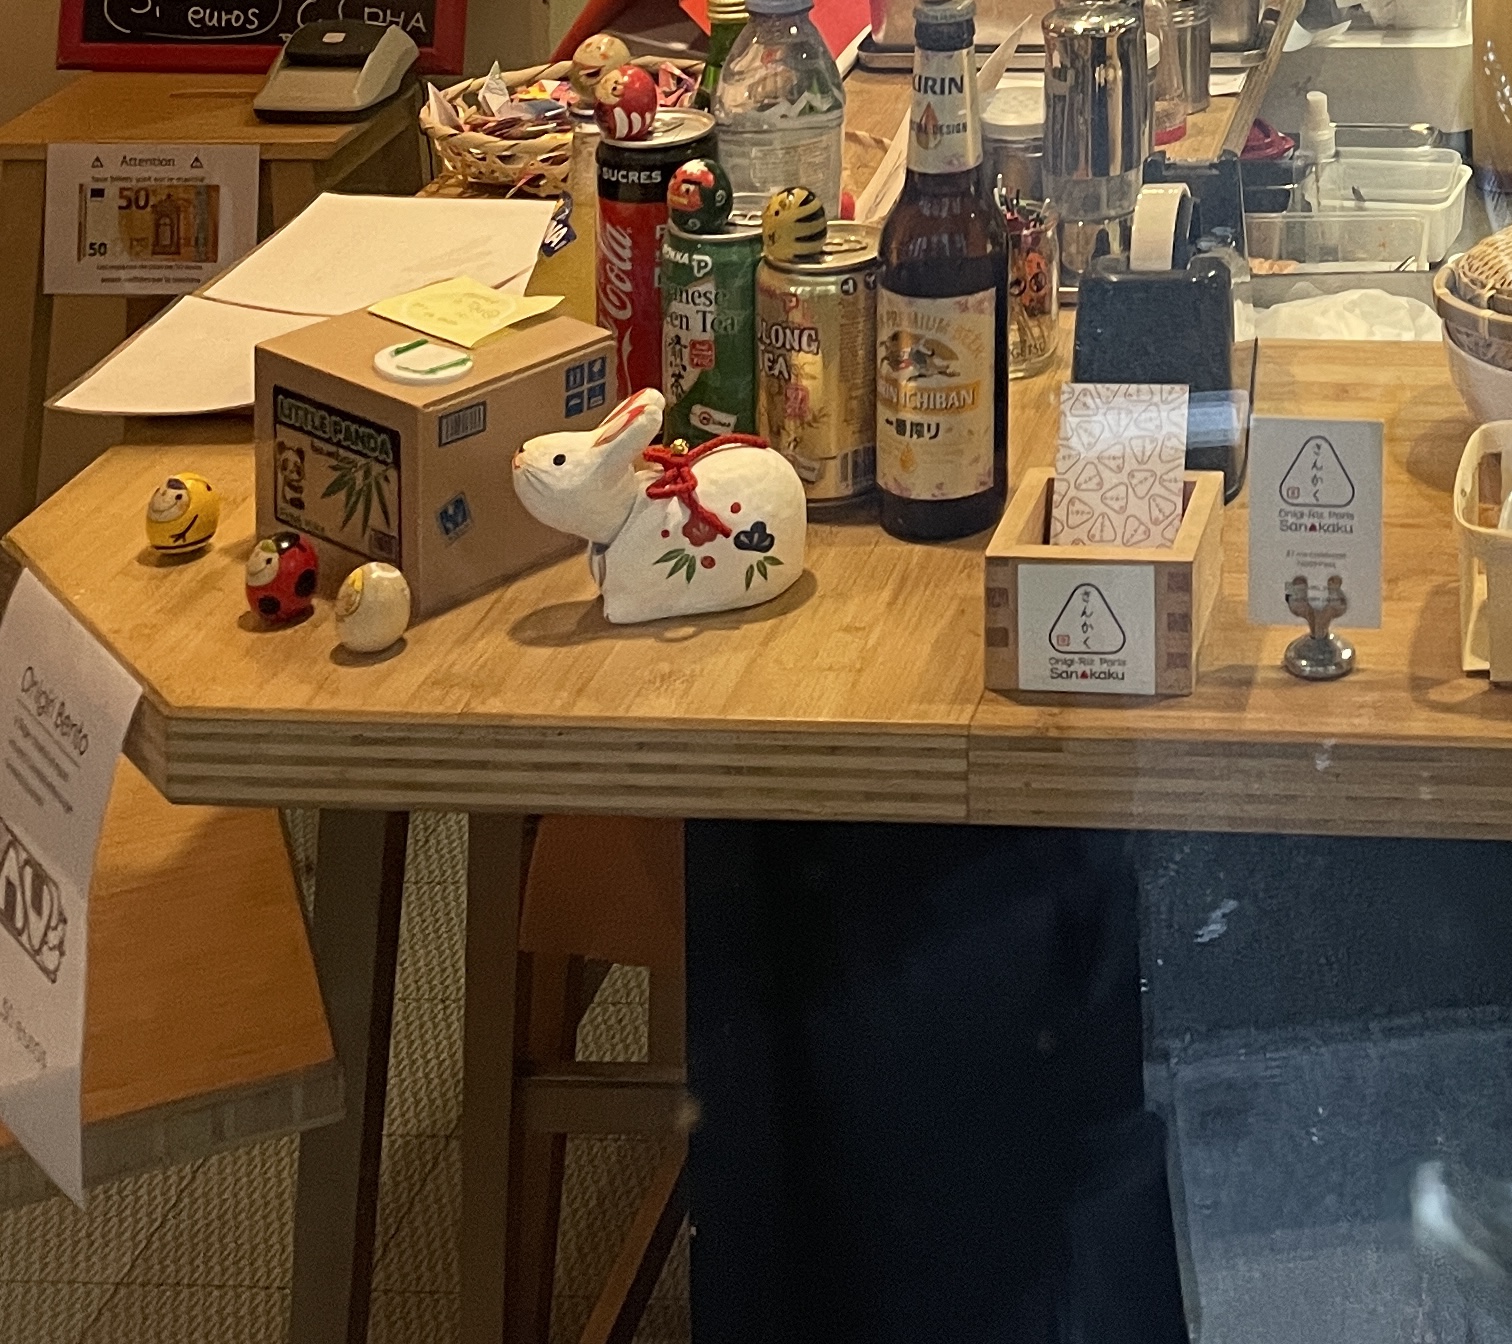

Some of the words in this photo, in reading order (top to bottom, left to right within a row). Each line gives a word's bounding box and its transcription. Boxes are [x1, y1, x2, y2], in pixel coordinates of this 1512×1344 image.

[187, 4, 260, 29] euros
[364, 6, 427, 34] DHA
[119, 155, 176, 168] Attention
[602, 167, 663, 185] SUCRES
[118, 186, 150, 211] 50
[87, 241, 108, 258] 50
